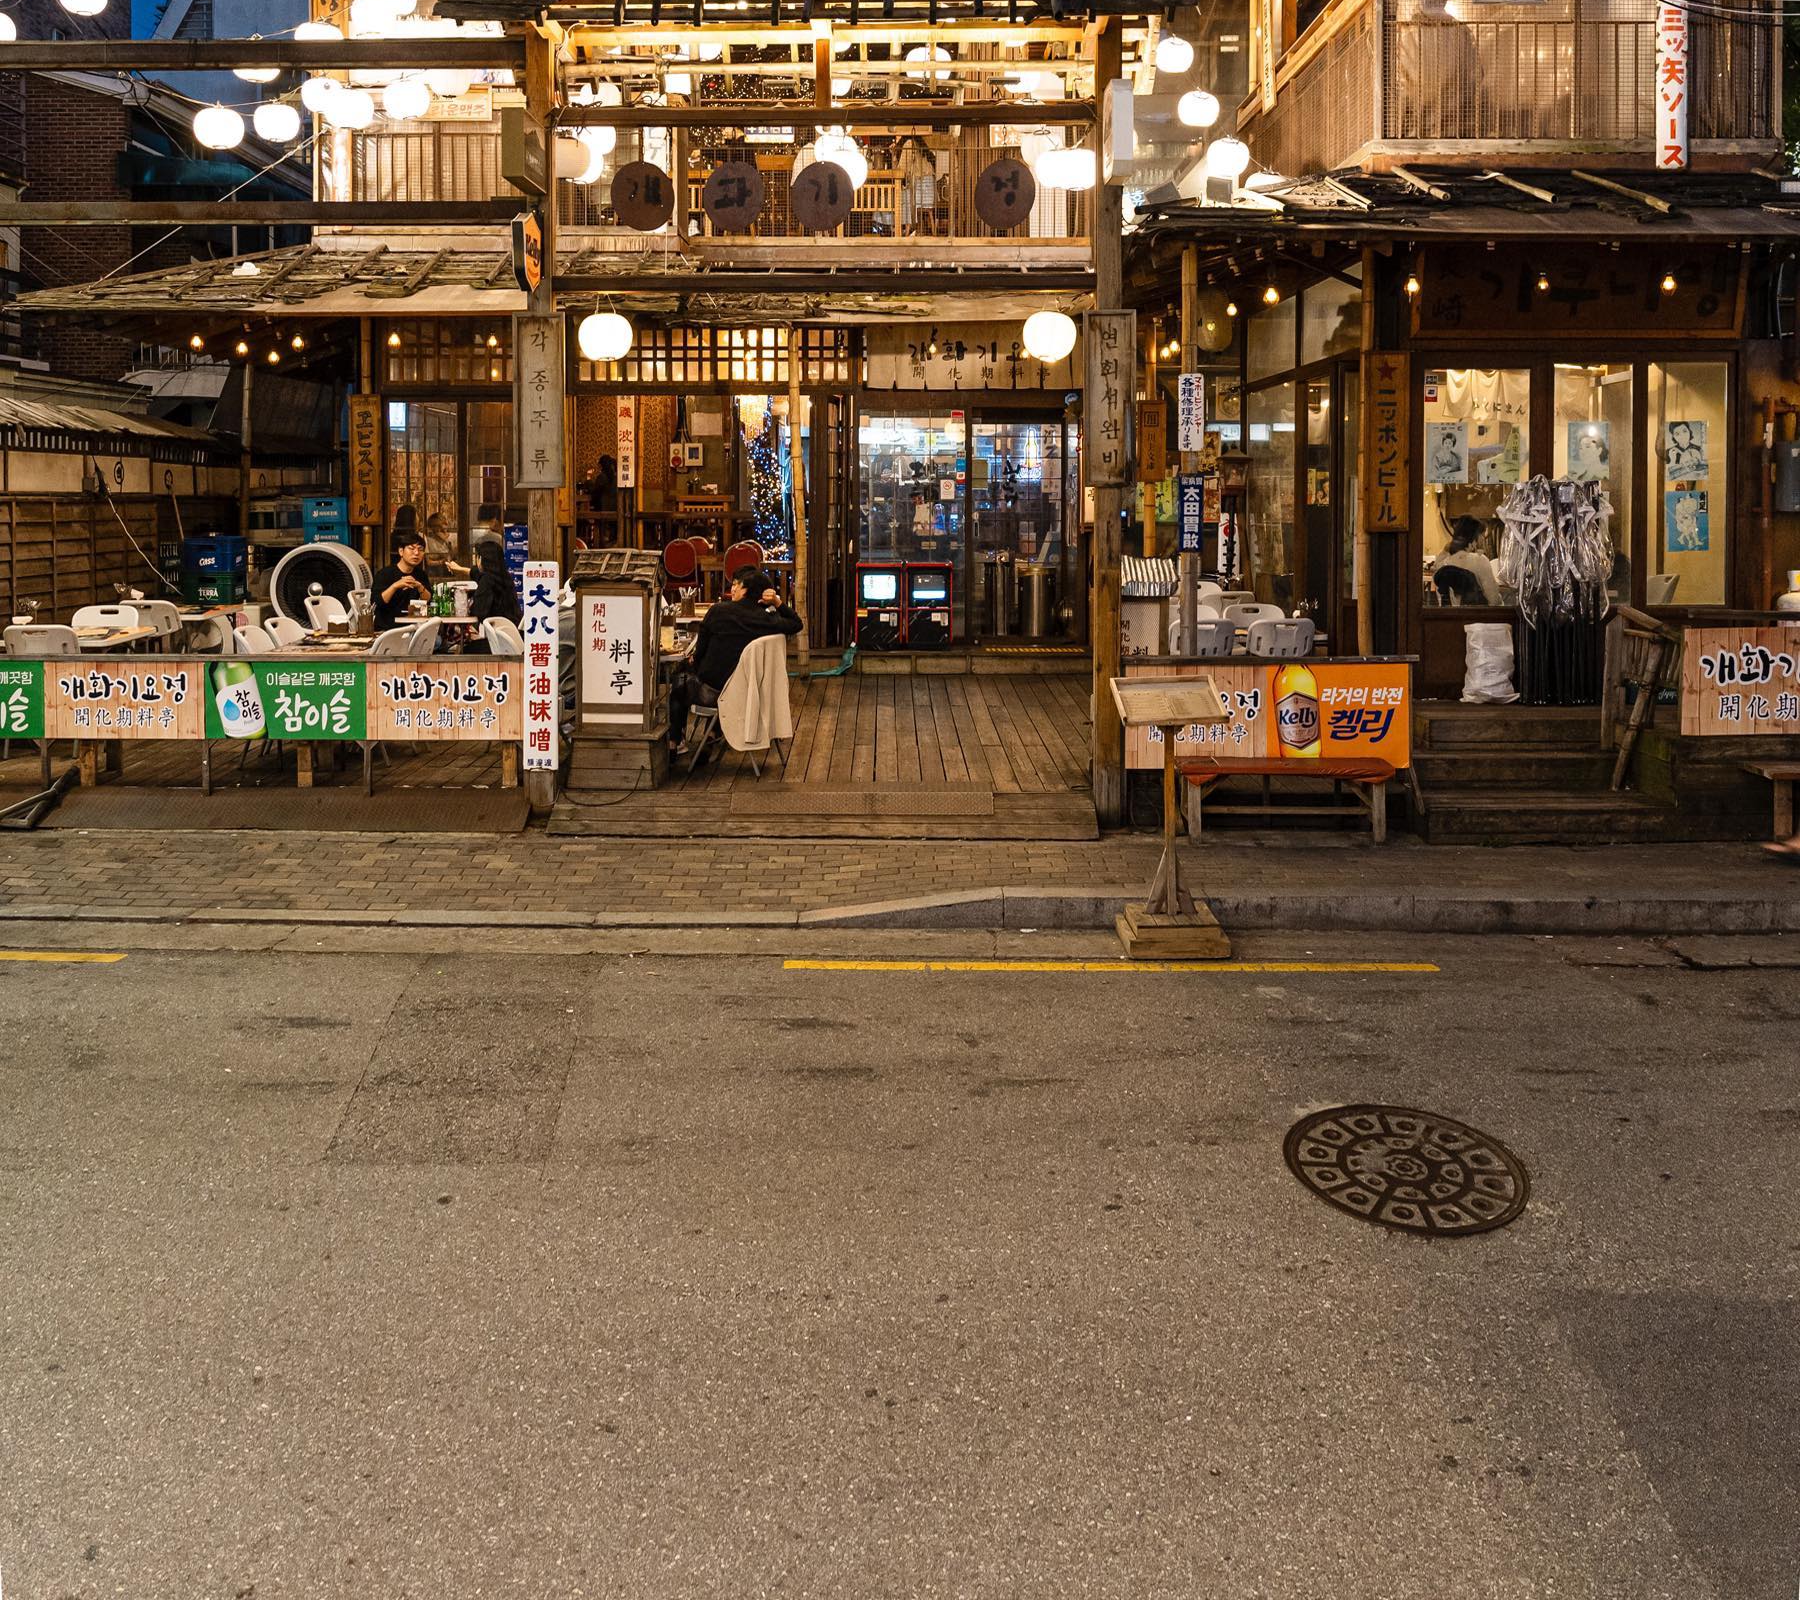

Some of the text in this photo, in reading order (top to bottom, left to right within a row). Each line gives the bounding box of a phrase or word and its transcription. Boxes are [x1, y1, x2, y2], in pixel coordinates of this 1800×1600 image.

[1661, 8, 1685, 168] 三ツ矢ソース
[908, 338, 1030, 363] 개화기요
[528, 330, 550, 472] 각종주류
[1376, 389, 1398, 523] ニッポンビール
[1183, 486, 1200, 550] 太田胃散
[592, 603, 607, 652] 開化期
[266, 672, 356, 686] 이슬같은 깨끗함
[609, 639, 635, 696] 料亭
[61, 673, 187, 703] 개화기요정
[235, 689, 250, 707] 참
[382, 673, 508, 703] 개화기요정
[1320, 687, 1404, 705] 라거의 반전
[75, 707, 175, 727] 開化期料亭
[242, 700, 262, 720] 이슬
[274, 688, 351, 734] 참이슬
[395, 709, 497, 728] 開化期料亭
[1278, 706, 1318, 728] Kelly
[1719, 694, 1798, 721] 開化期
[1327, 708, 1395, 743] 켈리
